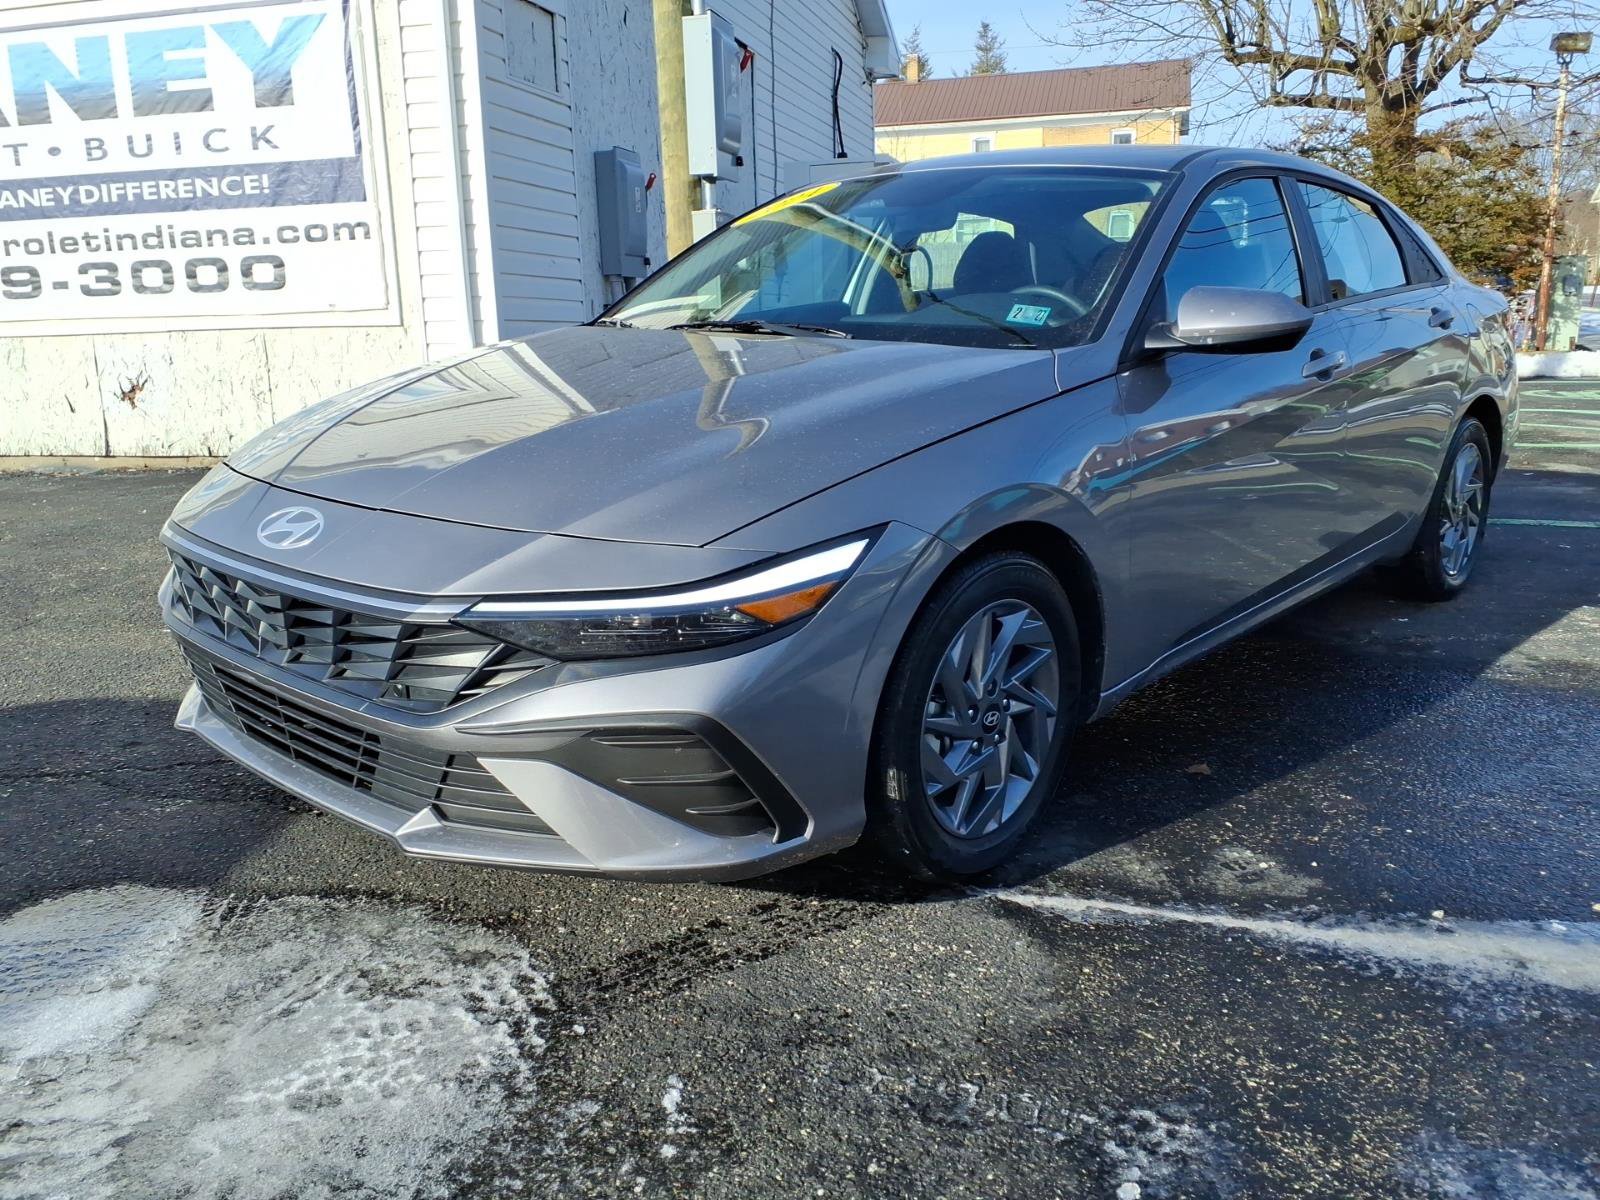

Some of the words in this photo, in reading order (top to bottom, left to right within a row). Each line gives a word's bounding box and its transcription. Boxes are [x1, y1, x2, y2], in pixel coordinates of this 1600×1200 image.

[0, 12, 327, 127] NEY
[84, 124, 281, 162] BUICK
[78, 174, 271, 205] DIFFERENCE!
[4, 220, 372, 257] roletindiana.com
[0, 254, 287, 300] 9-3000
[1012, 307, 1023, 319] 2
